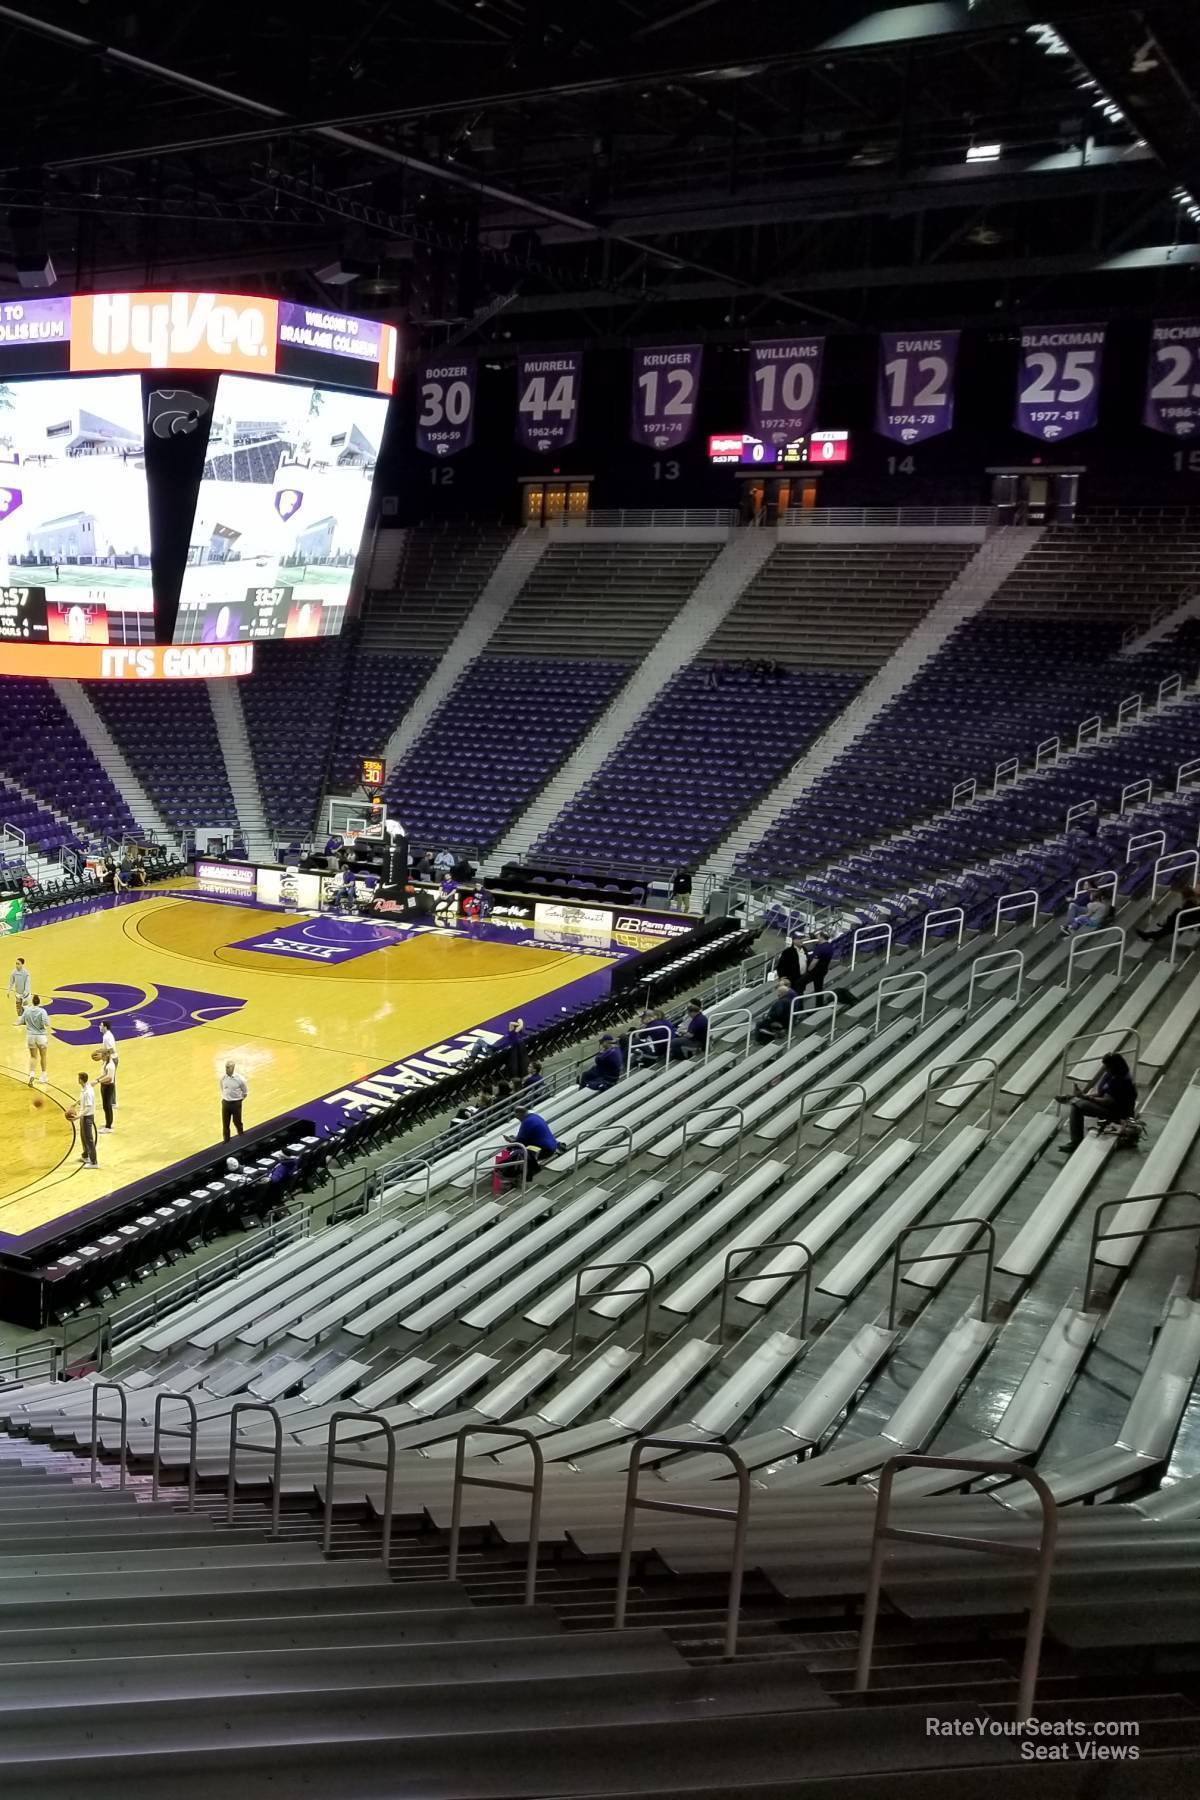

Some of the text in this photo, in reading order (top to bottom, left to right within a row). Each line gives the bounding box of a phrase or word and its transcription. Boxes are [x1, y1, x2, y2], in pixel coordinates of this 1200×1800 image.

[5, 305, 23, 320] TO
[306, 311, 358, 335] WELCOME TO
[896, 340, 942, 352] EVANS
[1021, 332, 1105, 348] BLACKMAN
[644, 354, 691, 365] KRUGER
[756, 346, 818, 359] WILLIAMS
[426, 367, 467, 379] BOOZER
[524, 360, 575, 372] MURRELL
[885, 357, 949, 406] 12
[1020, 351, 1096, 403] 25
[638, 369, 694, 416] 12
[755, 363, 814, 411] 10
[419, 381, 471, 426] 30
[519, 376, 575, 420] 44
[760, 419, 801, 428] 1972-76
[888, 415, 935, 424] 1974-78
[1030, 411, 1079, 421] 1977-81
[427, 431, 460, 441] 1956-59
[528, 427, 563, 436] 1962-64
[643, 423, 682, 433] 1971-74
[753, 444, 764, 461] 0
[822, 442, 834, 459] 0
[652, 461, 680, 480] 13
[887, 456, 915, 474] 14
[429, 467, 454, 485] 12
[101, 650, 155, 677] IT'S
[366, 770, 379, 783] 30
